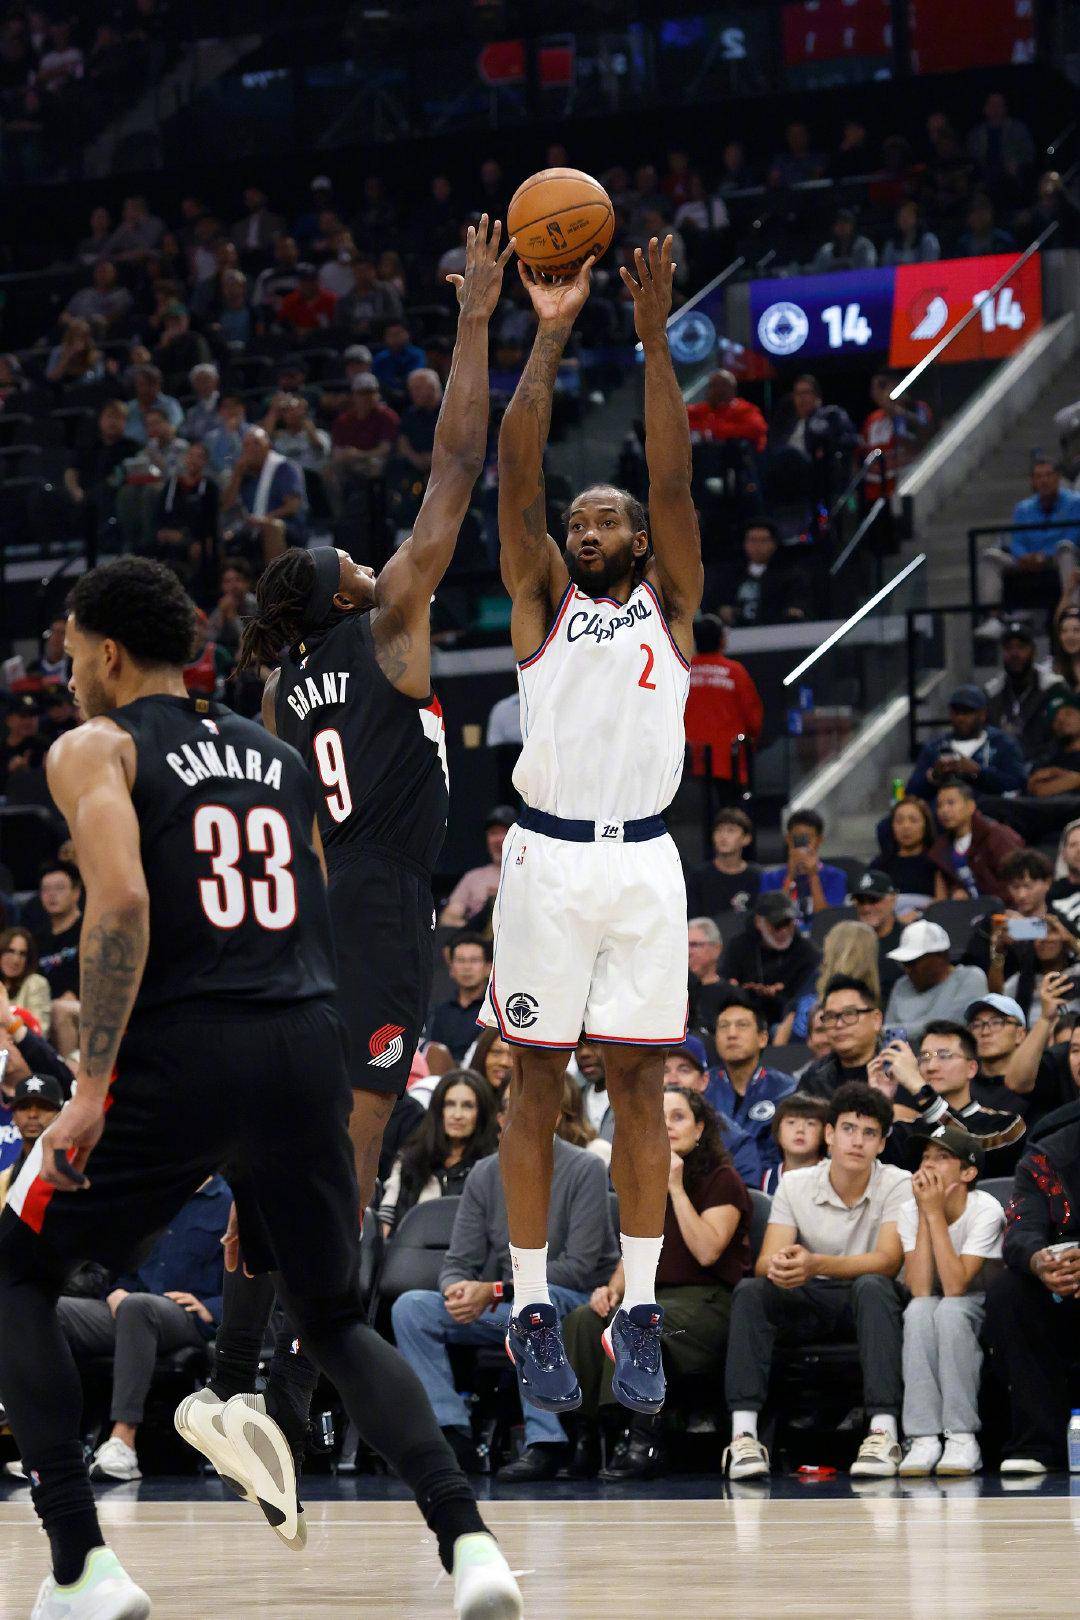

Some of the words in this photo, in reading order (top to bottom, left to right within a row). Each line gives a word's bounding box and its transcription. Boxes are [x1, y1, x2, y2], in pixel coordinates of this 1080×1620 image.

[821, 303, 872, 348] 14
[973, 287, 1025, 332] 14
[638, 643, 656, 690] 2
[287, 672, 350, 721] GRANT
[166, 741, 283, 791] CAMARA
[313, 727, 353, 823] 9
[193, 802, 298, 931] 33
